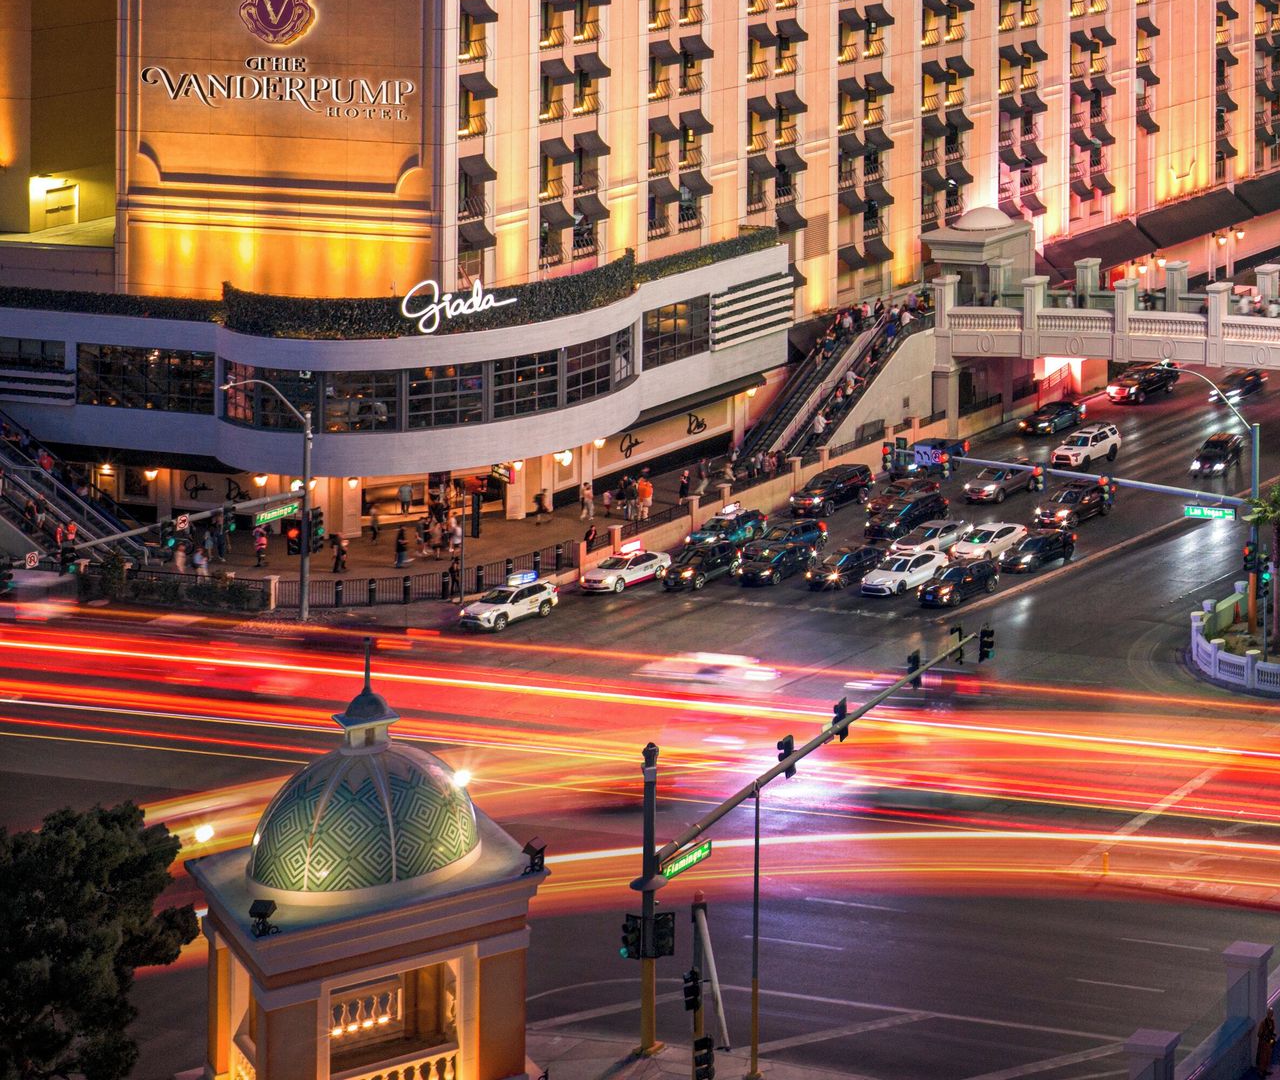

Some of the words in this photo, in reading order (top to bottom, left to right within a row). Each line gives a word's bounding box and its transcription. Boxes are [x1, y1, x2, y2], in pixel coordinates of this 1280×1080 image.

[245, 56, 306, 72] THE
[141, 66, 415, 112] VANDERPUMP
[326, 106, 409, 121] HOTEL
[402, 279, 517, 333] Giada
[260, 506, 293, 521] Flamingo
